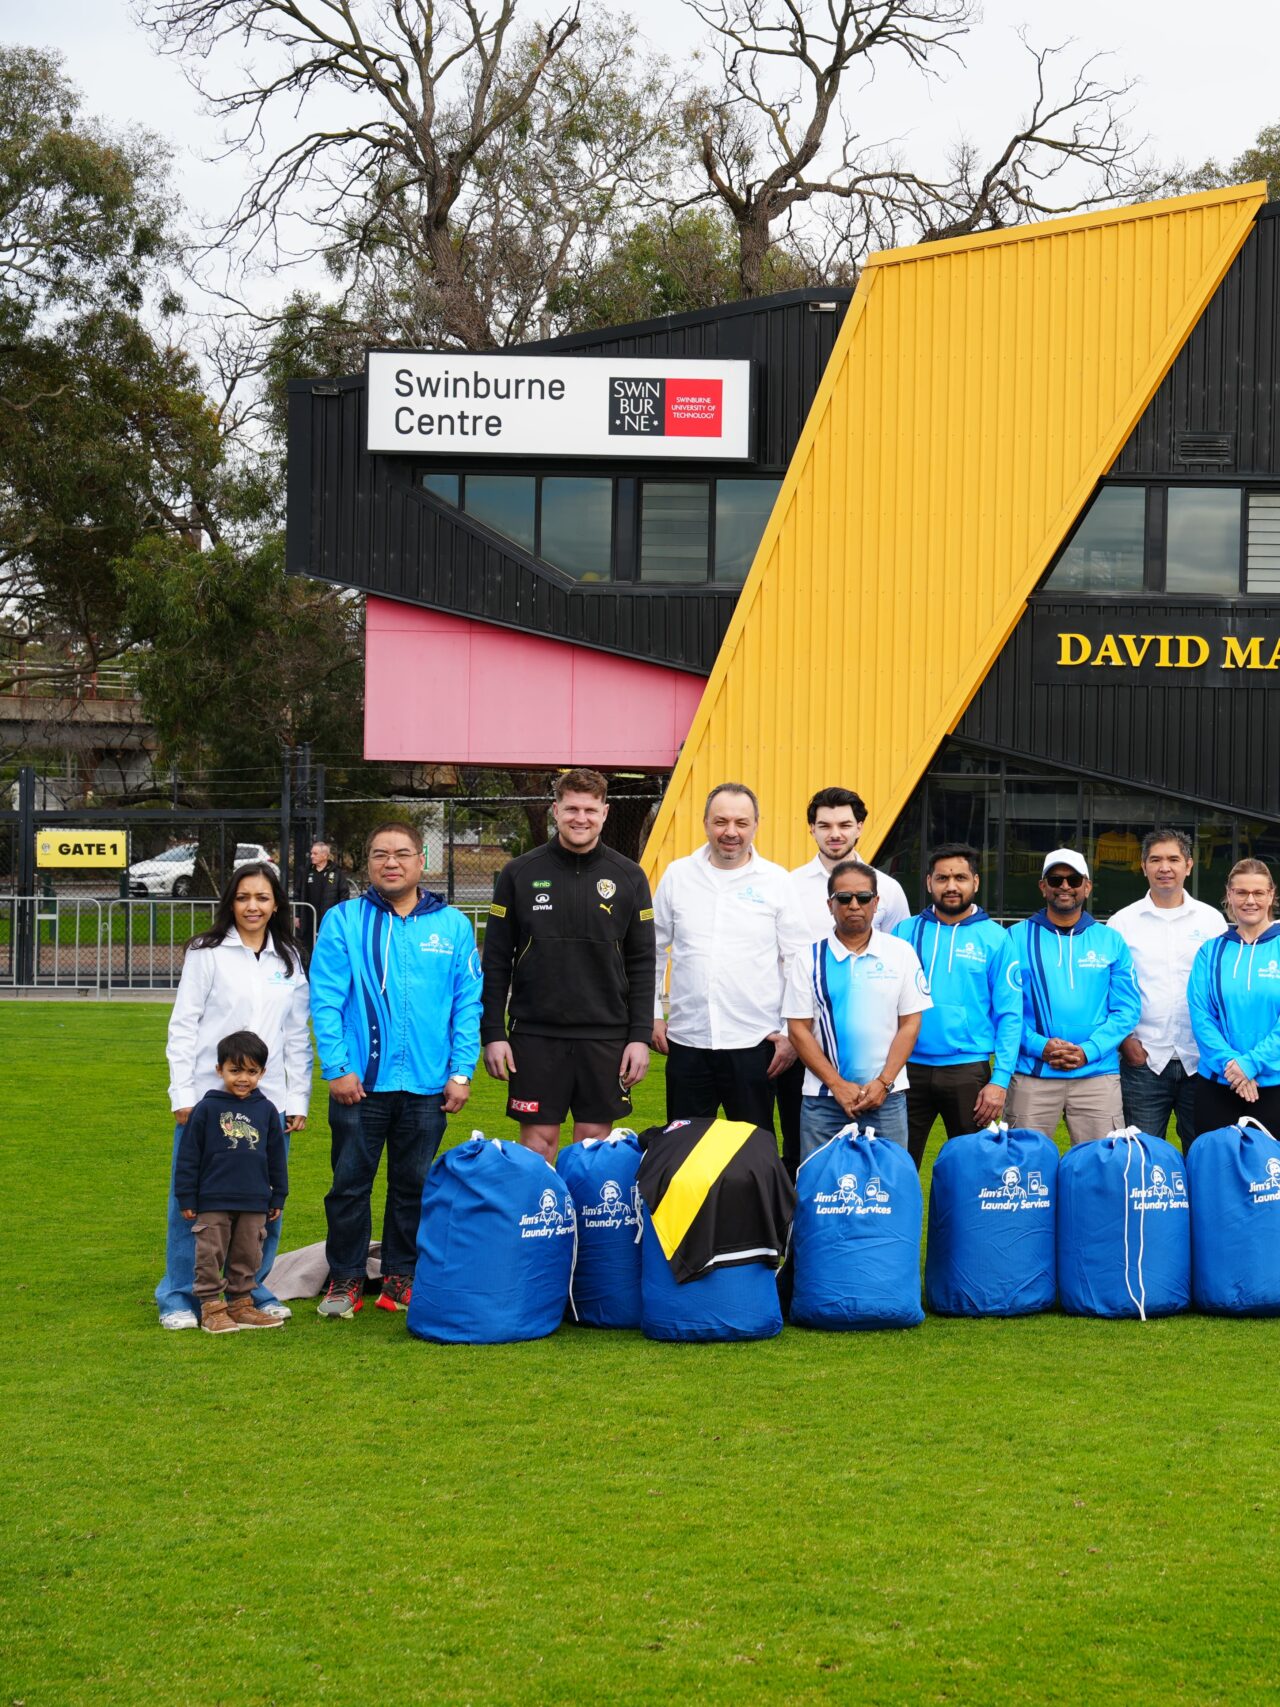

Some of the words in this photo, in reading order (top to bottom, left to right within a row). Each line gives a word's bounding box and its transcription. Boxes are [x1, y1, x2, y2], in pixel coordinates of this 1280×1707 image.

[395, 368, 566, 400] Swinburne
[620, 398, 655, 415] BUR
[395, 406, 502, 436] Centre
[624, 415, 650, 431] NE
[1057, 632, 1210, 668] DAVID
[58, 843, 106, 855] GATE
[110, 844, 117, 855] 1
[512, 1098, 536, 1112] KFC
[978, 1188, 1002, 1198] Jim's
[1249, 1182, 1270, 1192] Jim's
[813, 1192, 837, 1202] Jim's
[582, 1205, 602, 1215] Jim's
[816, 1203, 854, 1215] Laundry
[855, 1204, 891, 1214] Services
[981, 1200, 1019, 1212] Laundry
[1134, 1199, 1168, 1211] Laundry
[519, 1214, 538, 1226] Jim's
[585, 1217, 622, 1229] Laundry
[522, 1226, 555, 1238] Laundry
